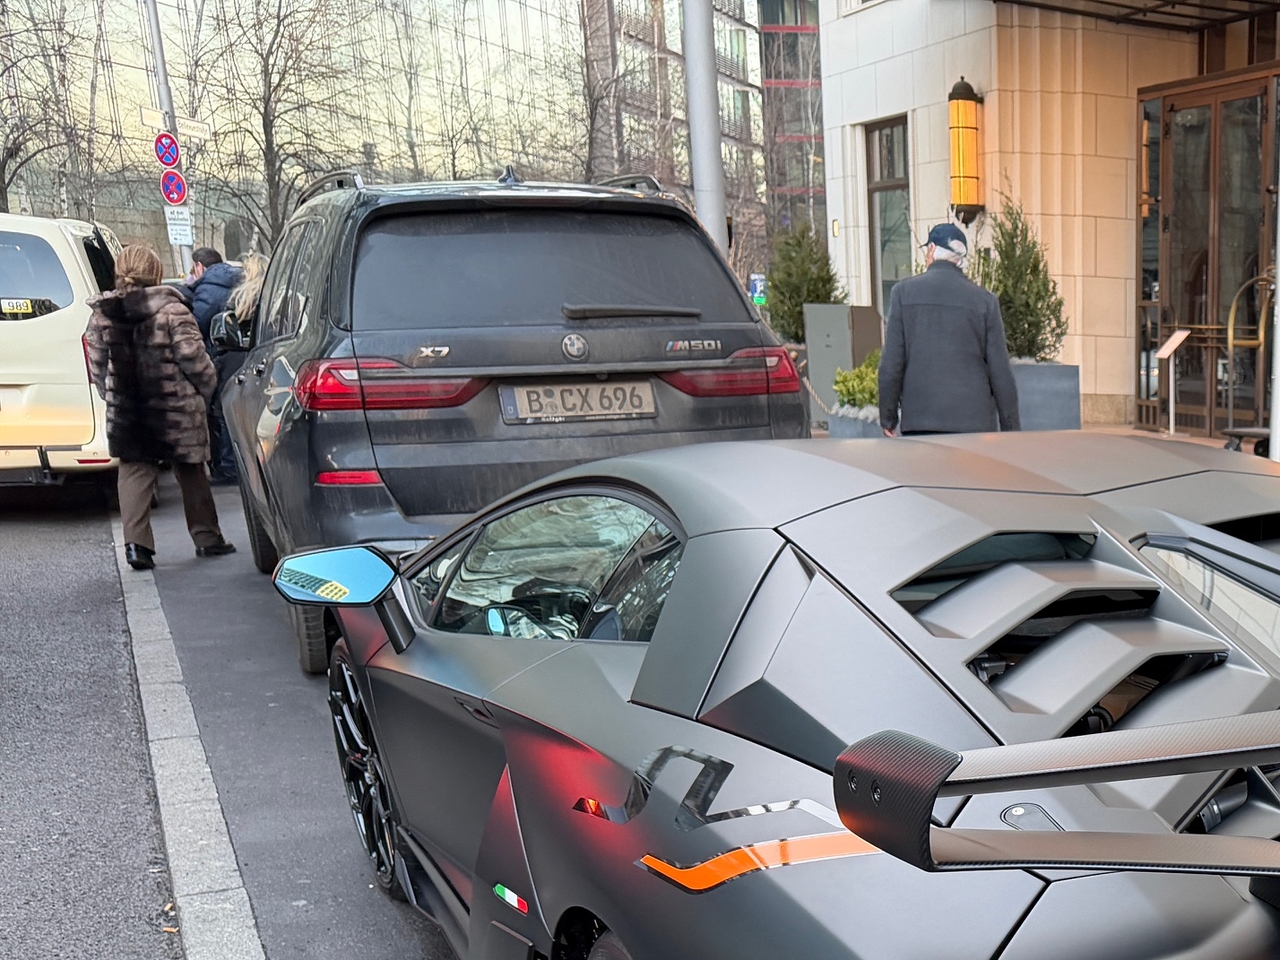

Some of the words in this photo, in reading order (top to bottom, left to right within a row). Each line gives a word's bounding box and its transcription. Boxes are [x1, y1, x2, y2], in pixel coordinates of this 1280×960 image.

[7, 301, 29, 311] 989
[420, 346, 450, 358] X7
[525, 389, 544, 414] B
[559, 388, 594, 412] CX
[600, 386, 643, 411] 696
